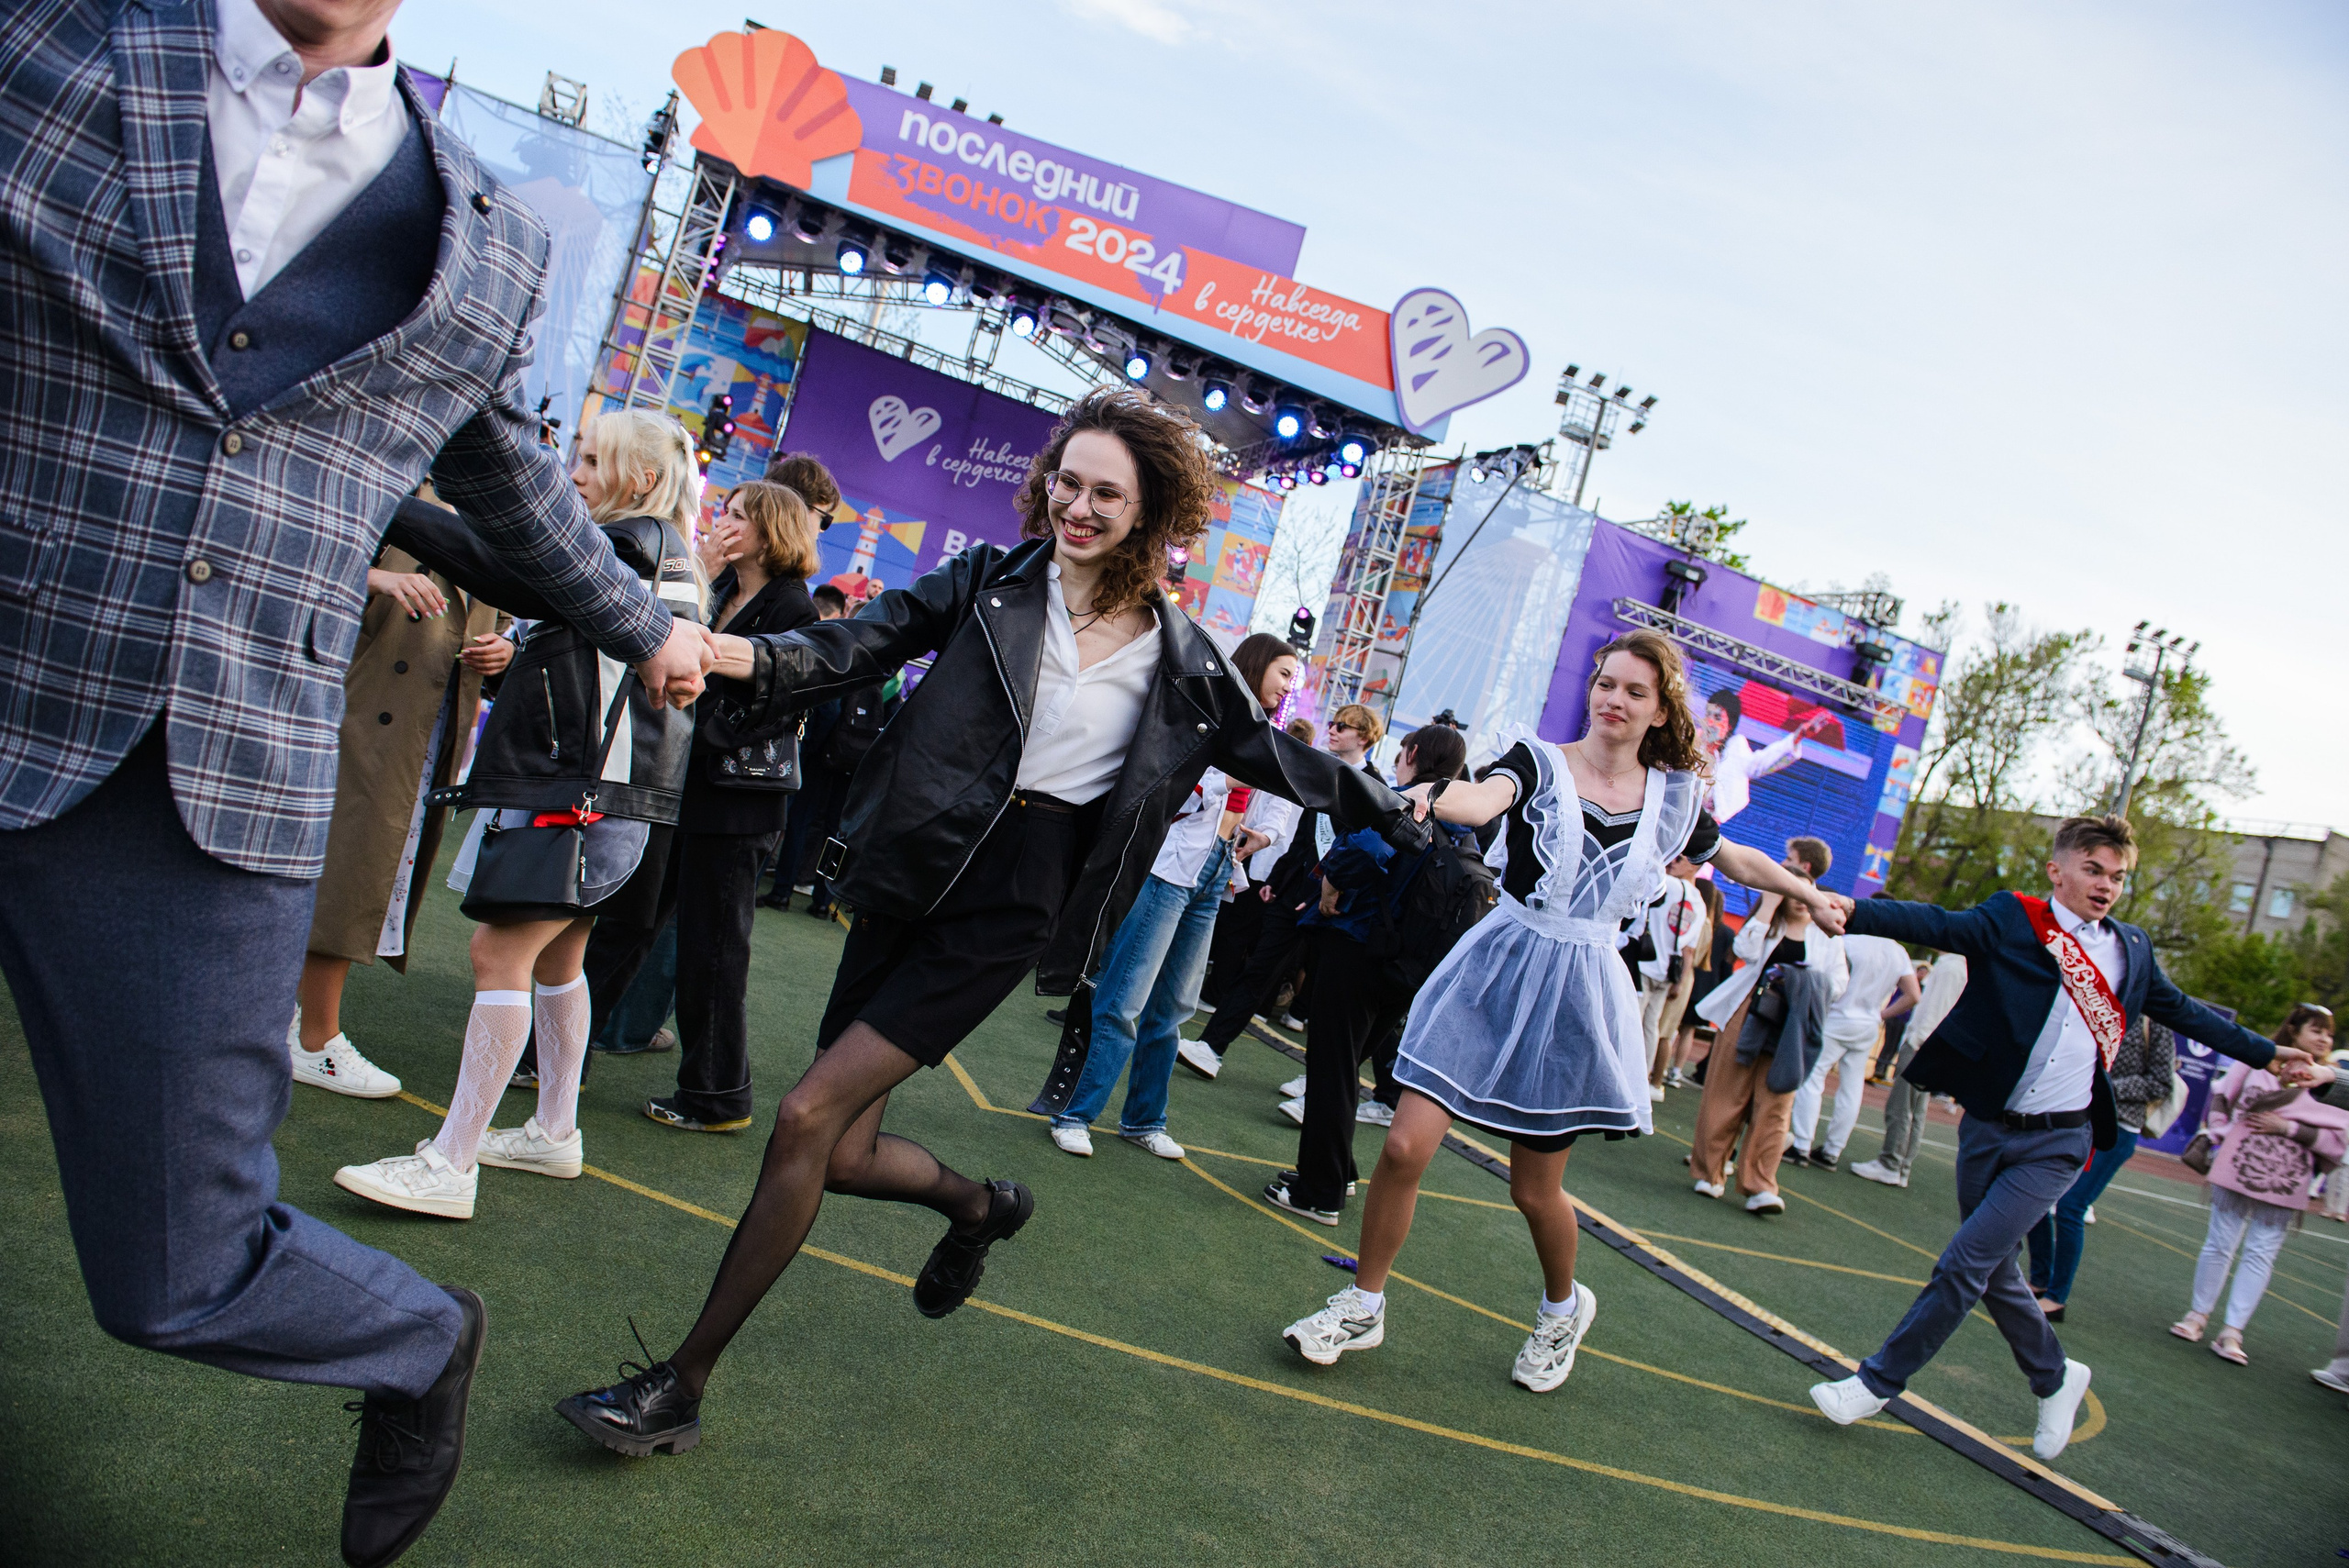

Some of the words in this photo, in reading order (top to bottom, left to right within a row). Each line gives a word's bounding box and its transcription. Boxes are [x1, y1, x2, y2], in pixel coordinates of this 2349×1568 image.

[898, 108, 1140, 221] последний
[1064, 217, 1183, 295] 2024
[1194, 281, 1217, 312] в
[1215, 300, 1320, 344] сердечке
[1251, 274, 1363, 341] Навсегда
[925, 443, 942, 467] в
[941, 457, 1023, 489] сердечке
[968, 437, 1034, 471] Навсег
